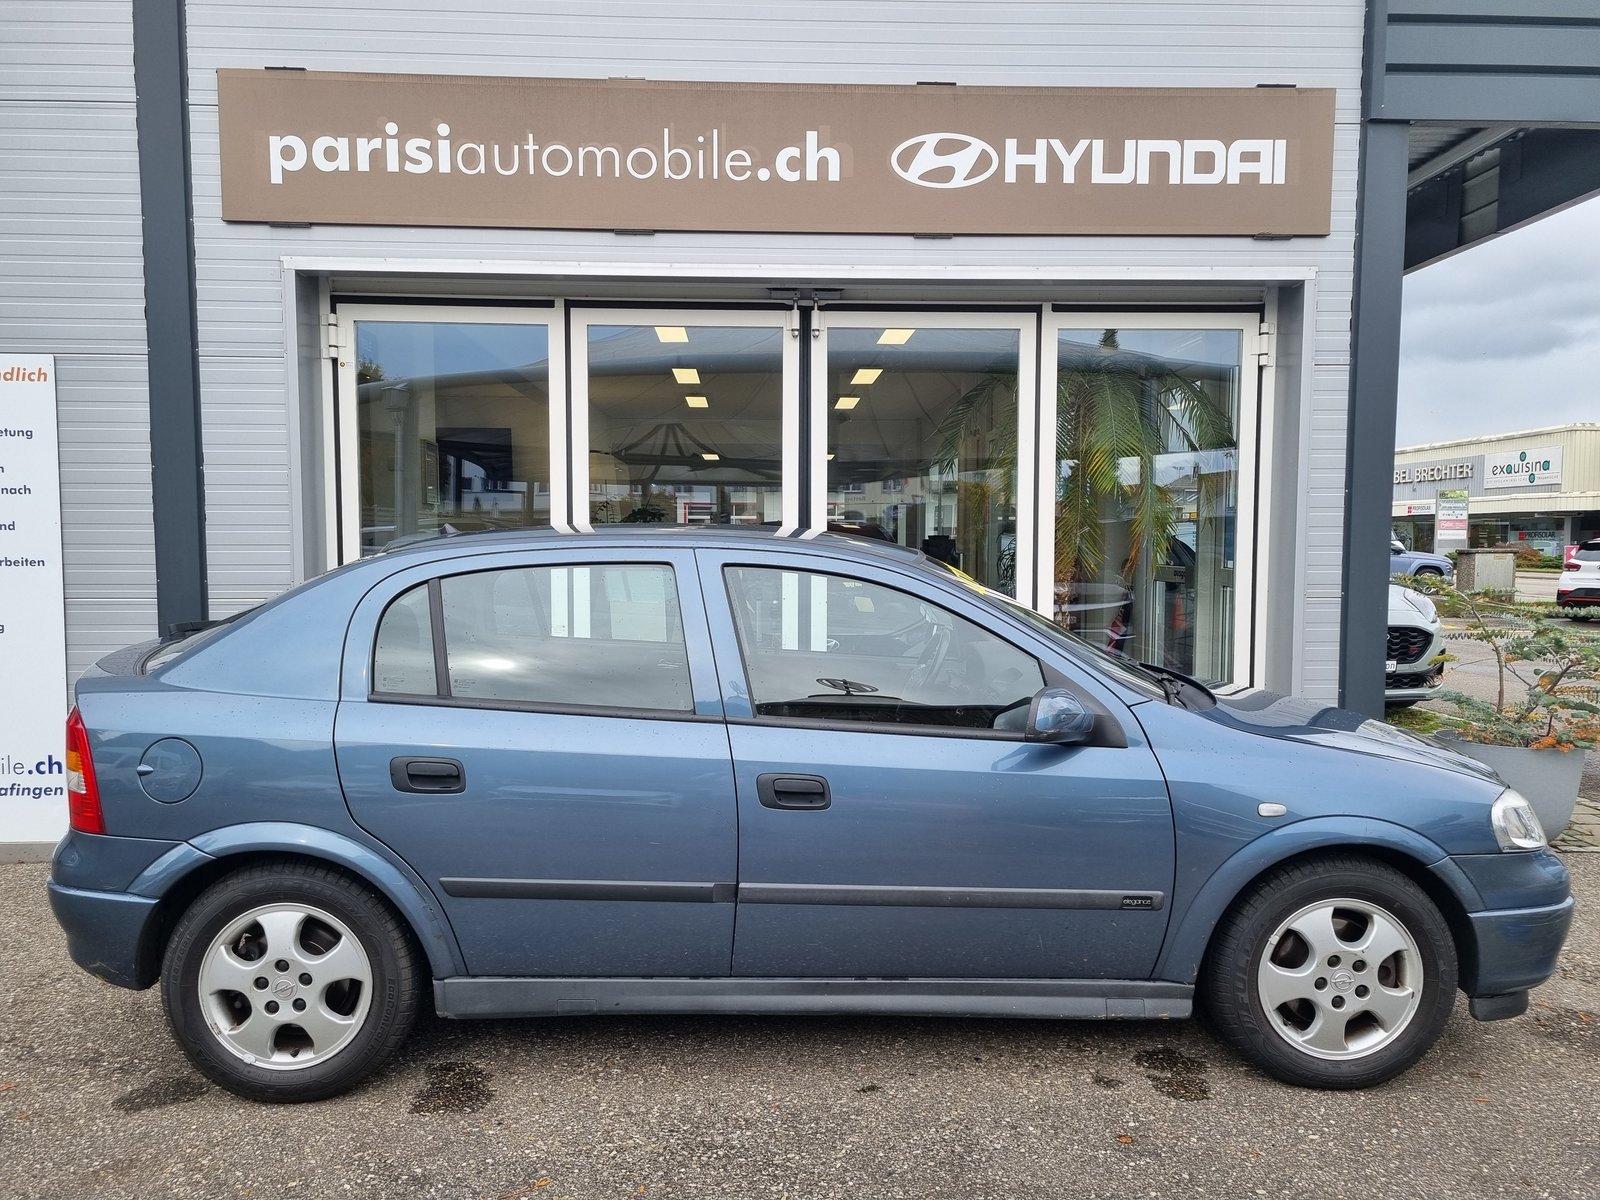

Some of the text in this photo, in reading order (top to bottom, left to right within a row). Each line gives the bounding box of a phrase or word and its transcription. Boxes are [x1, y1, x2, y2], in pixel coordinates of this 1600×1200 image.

[269, 122, 1287, 185] parisiautomobile.ch HYUNDAI
[0, 367, 47, 382] dlich
[1415, 463, 1473, 482] BRECHTER
[1492, 452, 1550, 476] exquisina
[1, 485, 32, 495] nach
[0, 782, 64, 799] afingen
[1122, 898, 1152, 906] elegance
